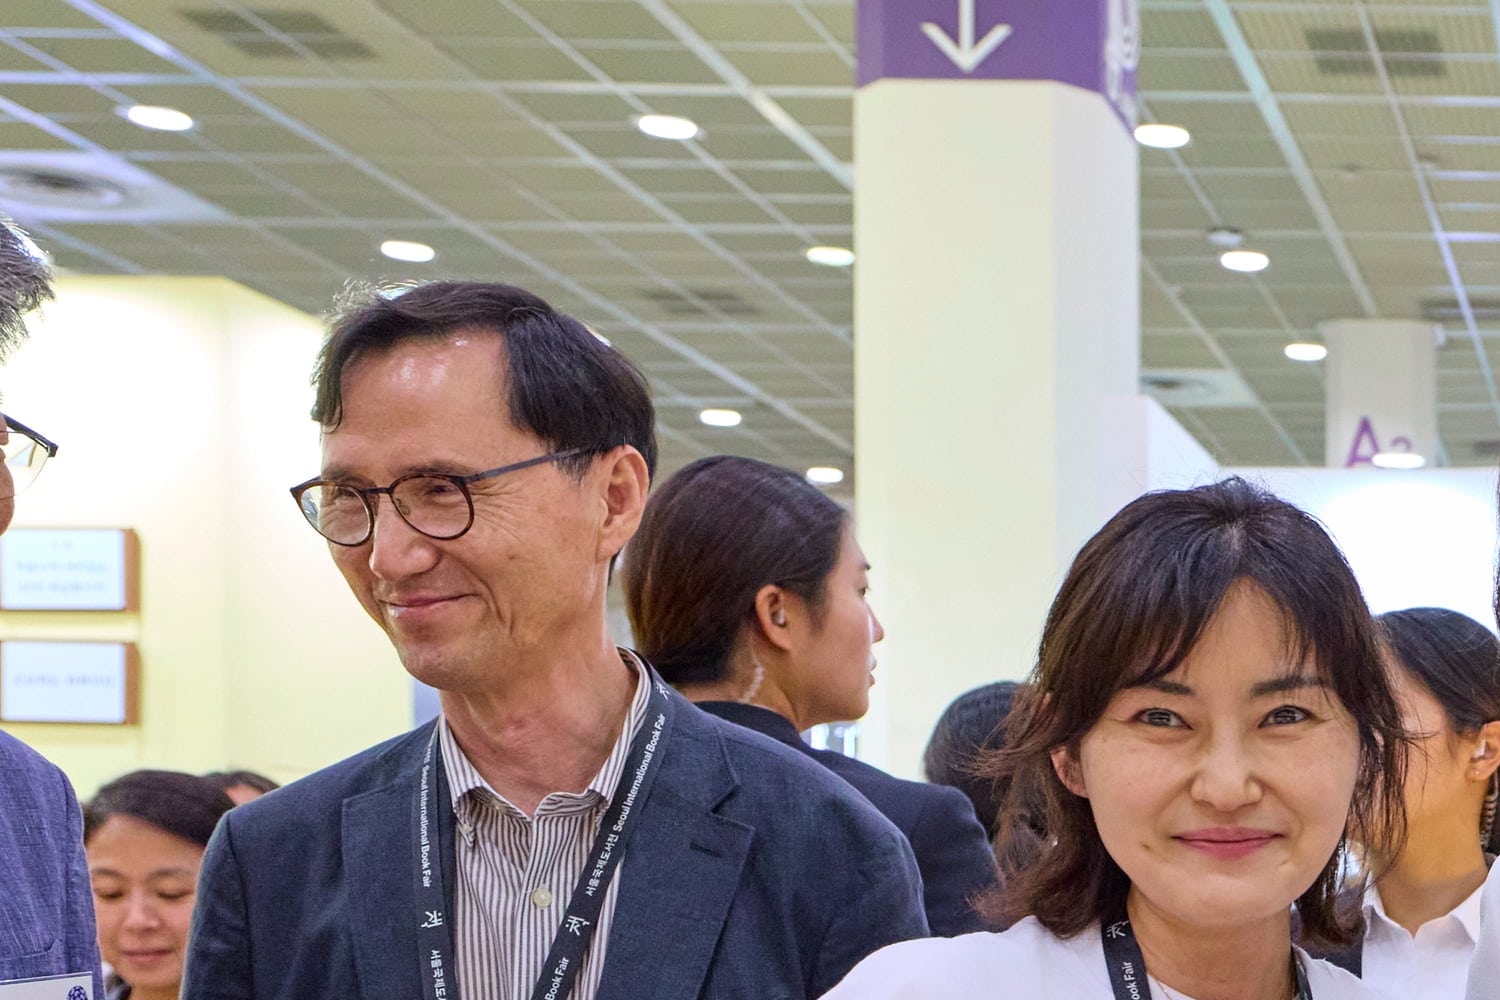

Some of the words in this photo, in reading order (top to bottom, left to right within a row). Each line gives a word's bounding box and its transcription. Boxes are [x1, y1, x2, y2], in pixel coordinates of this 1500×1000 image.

[613, 803, 631, 832] Seoul
[626, 750, 653, 807] International
[645, 728, 660, 753] Book
[654, 713, 666, 731] Fair
[421, 790, 430, 845] International
[422, 845, 430, 869] Book
[423, 869, 431, 888] Fair
[555, 956, 570, 978] Fair
[1123, 961, 1134, 982] Fair
